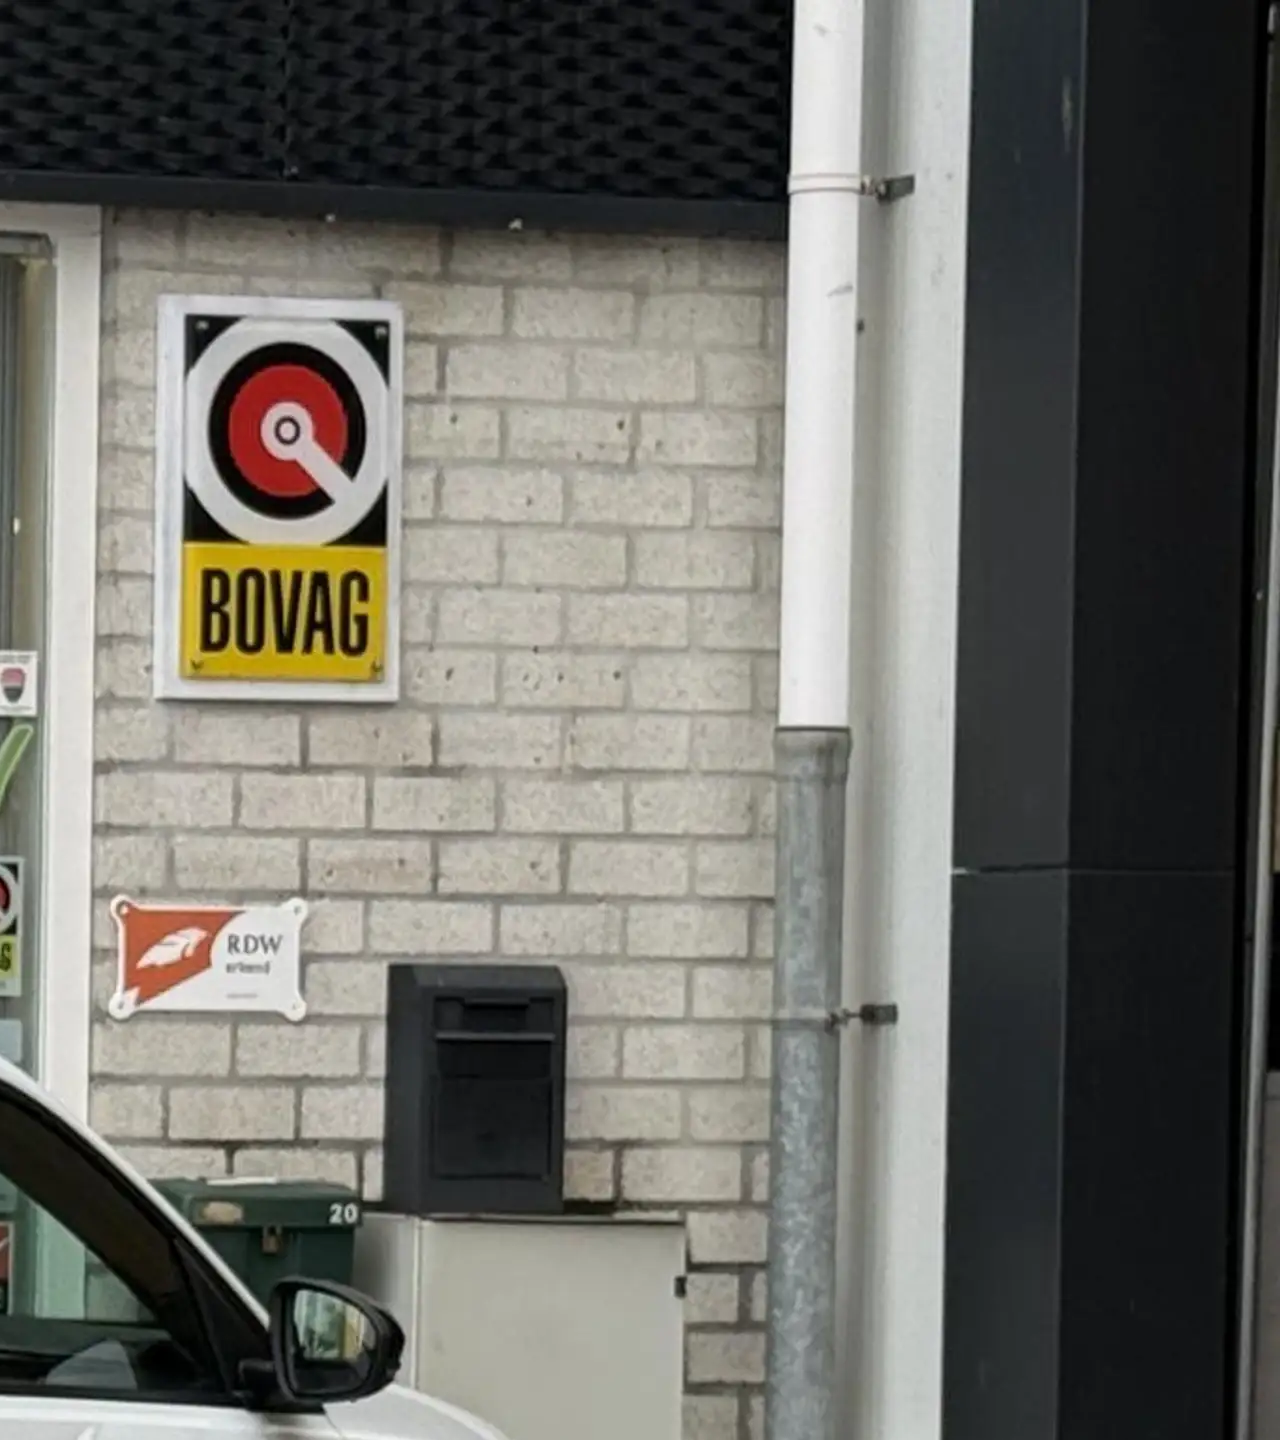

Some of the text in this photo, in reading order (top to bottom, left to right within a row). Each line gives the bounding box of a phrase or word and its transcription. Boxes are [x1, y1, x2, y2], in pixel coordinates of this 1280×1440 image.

[200, 567, 370, 656] BOVAG
[227, 934, 283, 956] RDW
[329, 1203, 358, 1224] 20
